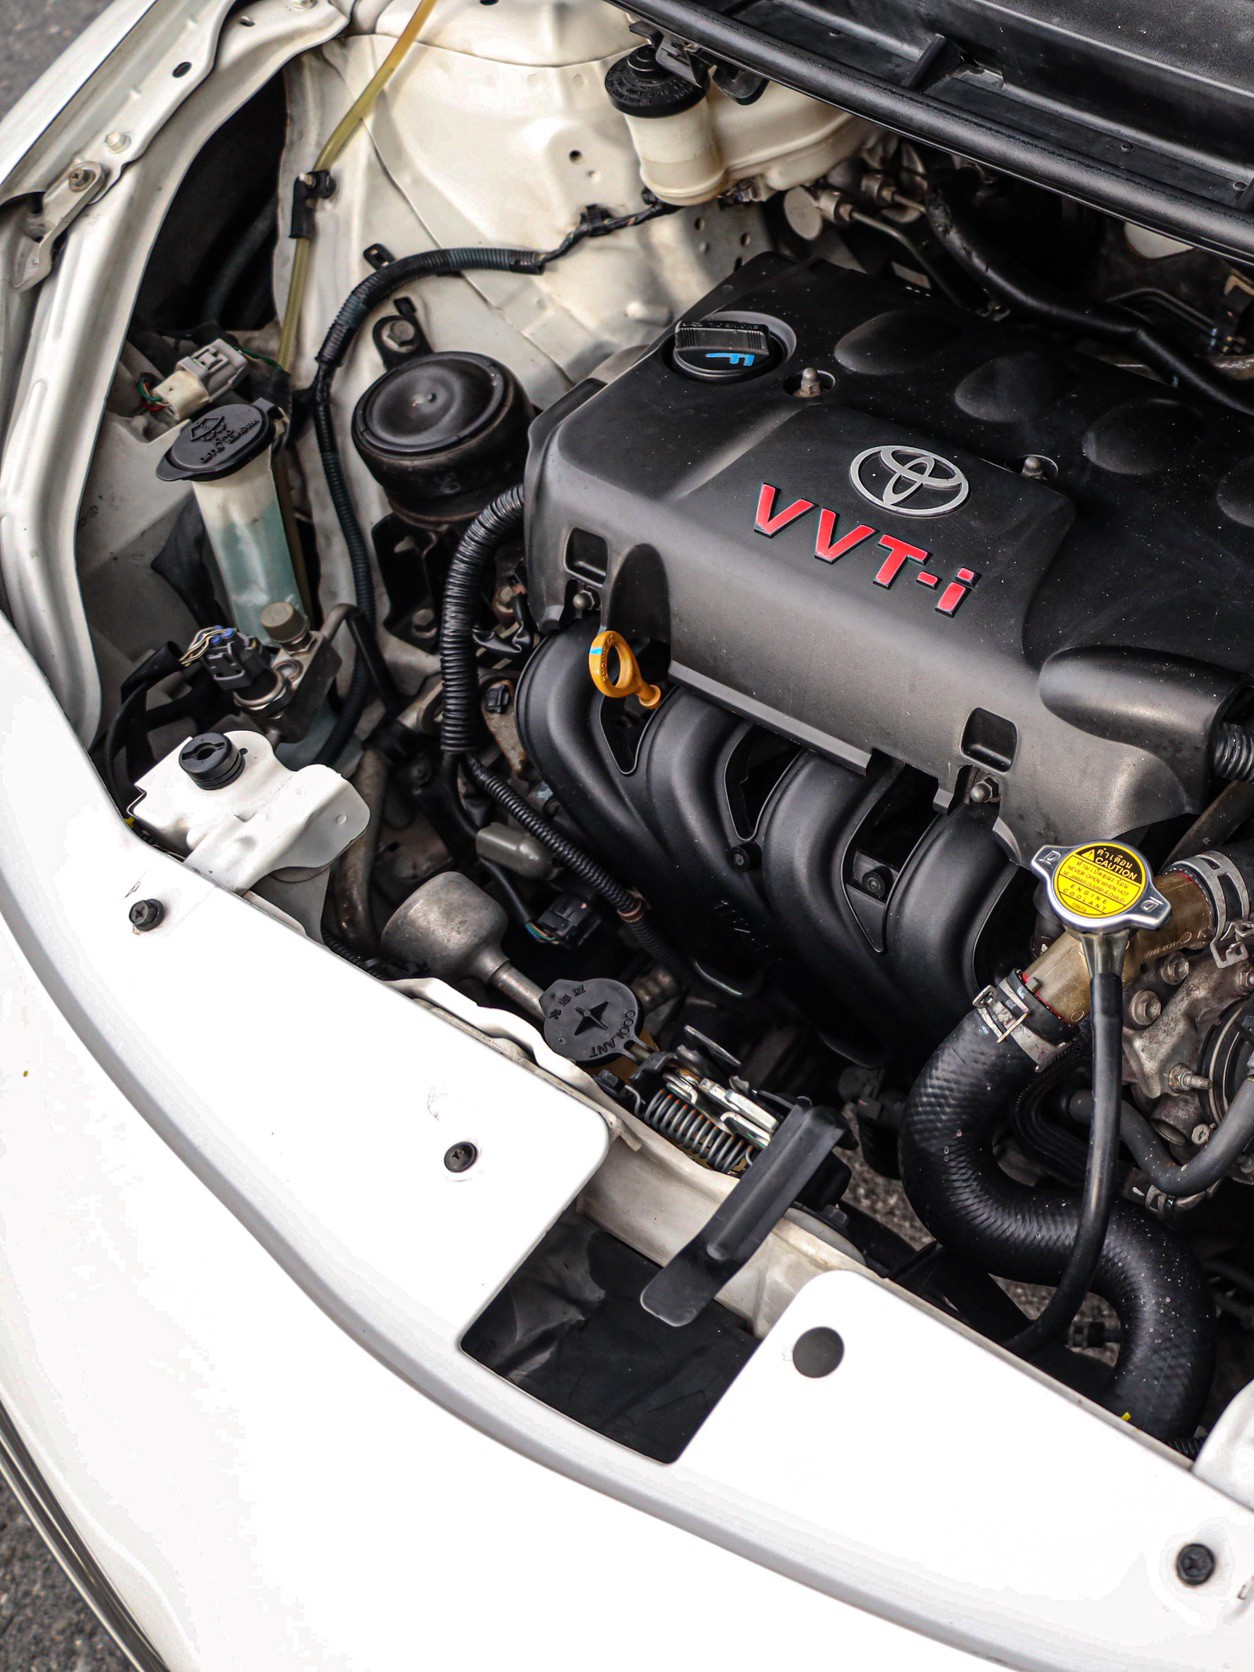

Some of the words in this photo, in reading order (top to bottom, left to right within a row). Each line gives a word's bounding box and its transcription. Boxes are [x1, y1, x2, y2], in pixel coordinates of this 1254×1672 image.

[754, 481, 977, 618] VVT-i
[1067, 865, 1085, 876] NEVER
[1086, 873, 1100, 884] OPEN
[1100, 880, 1117, 892] WHEN
[1118, 888, 1130, 897] HOT
[1095, 857, 1138, 880] CAUTION
[1063, 888, 1107, 911] COOLANT
[1070, 883, 1108, 904] ENGINE
[589, 1009, 636, 1058] COOLANT
